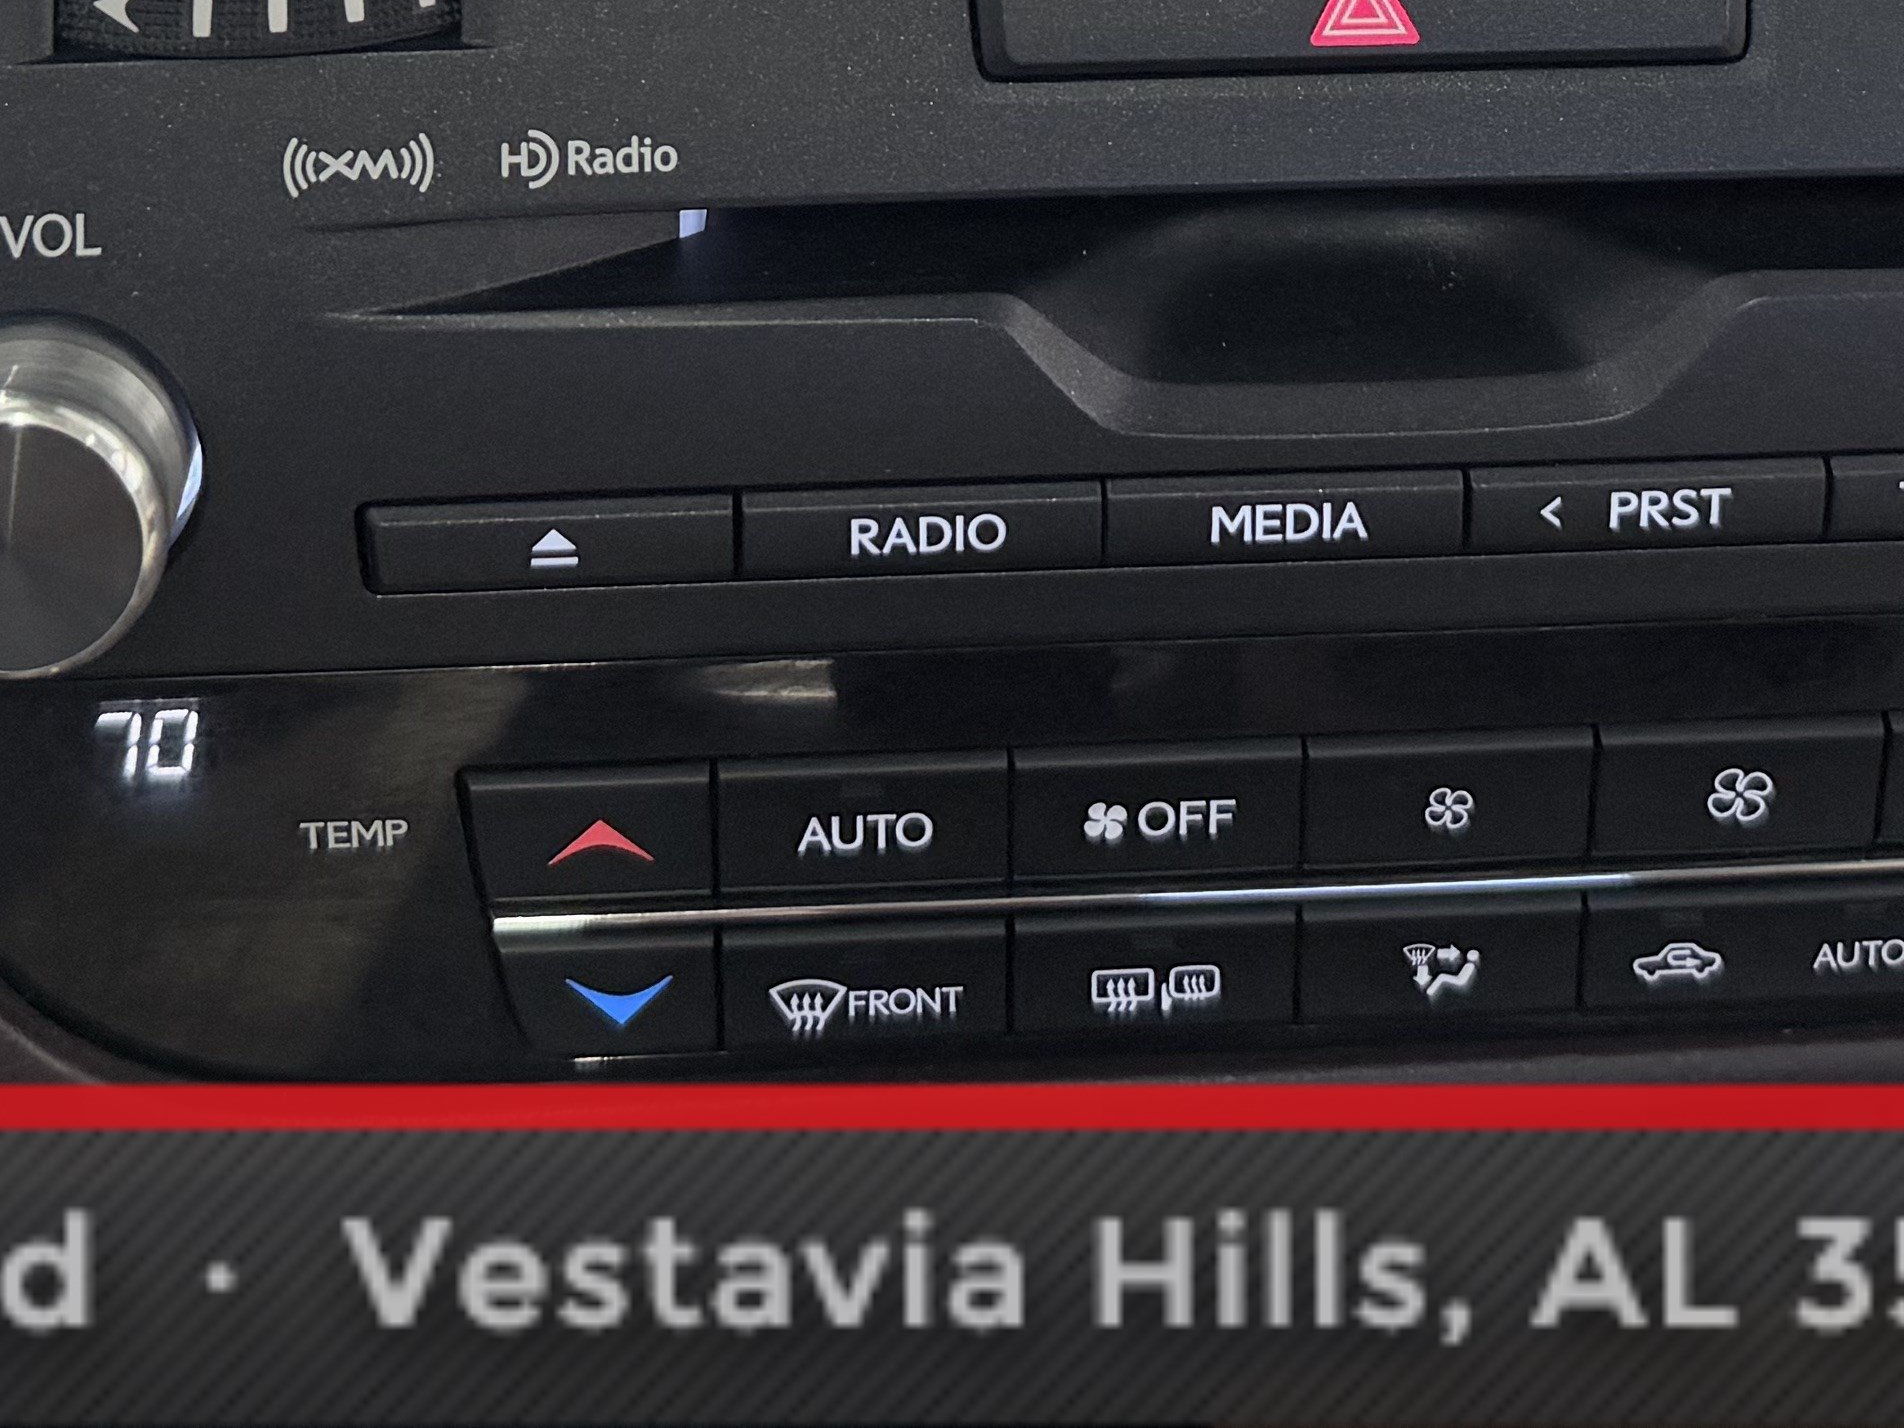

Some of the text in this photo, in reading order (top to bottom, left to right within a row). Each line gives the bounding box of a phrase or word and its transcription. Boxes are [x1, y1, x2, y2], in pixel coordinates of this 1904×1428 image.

[500, 129, 680, 190] HD Radio
[1209, 499, 1368, 546] MEDIA
[1607, 486, 1733, 532] PRST
[848, 511, 1008, 558] RADIO
[95, 706, 201, 778] 70
[298, 818, 410, 853] TEMP
[797, 811, 935, 857] AUTO
[1135, 797, 1237, 842] OFF
[846, 984, 965, 1023] FRONT
